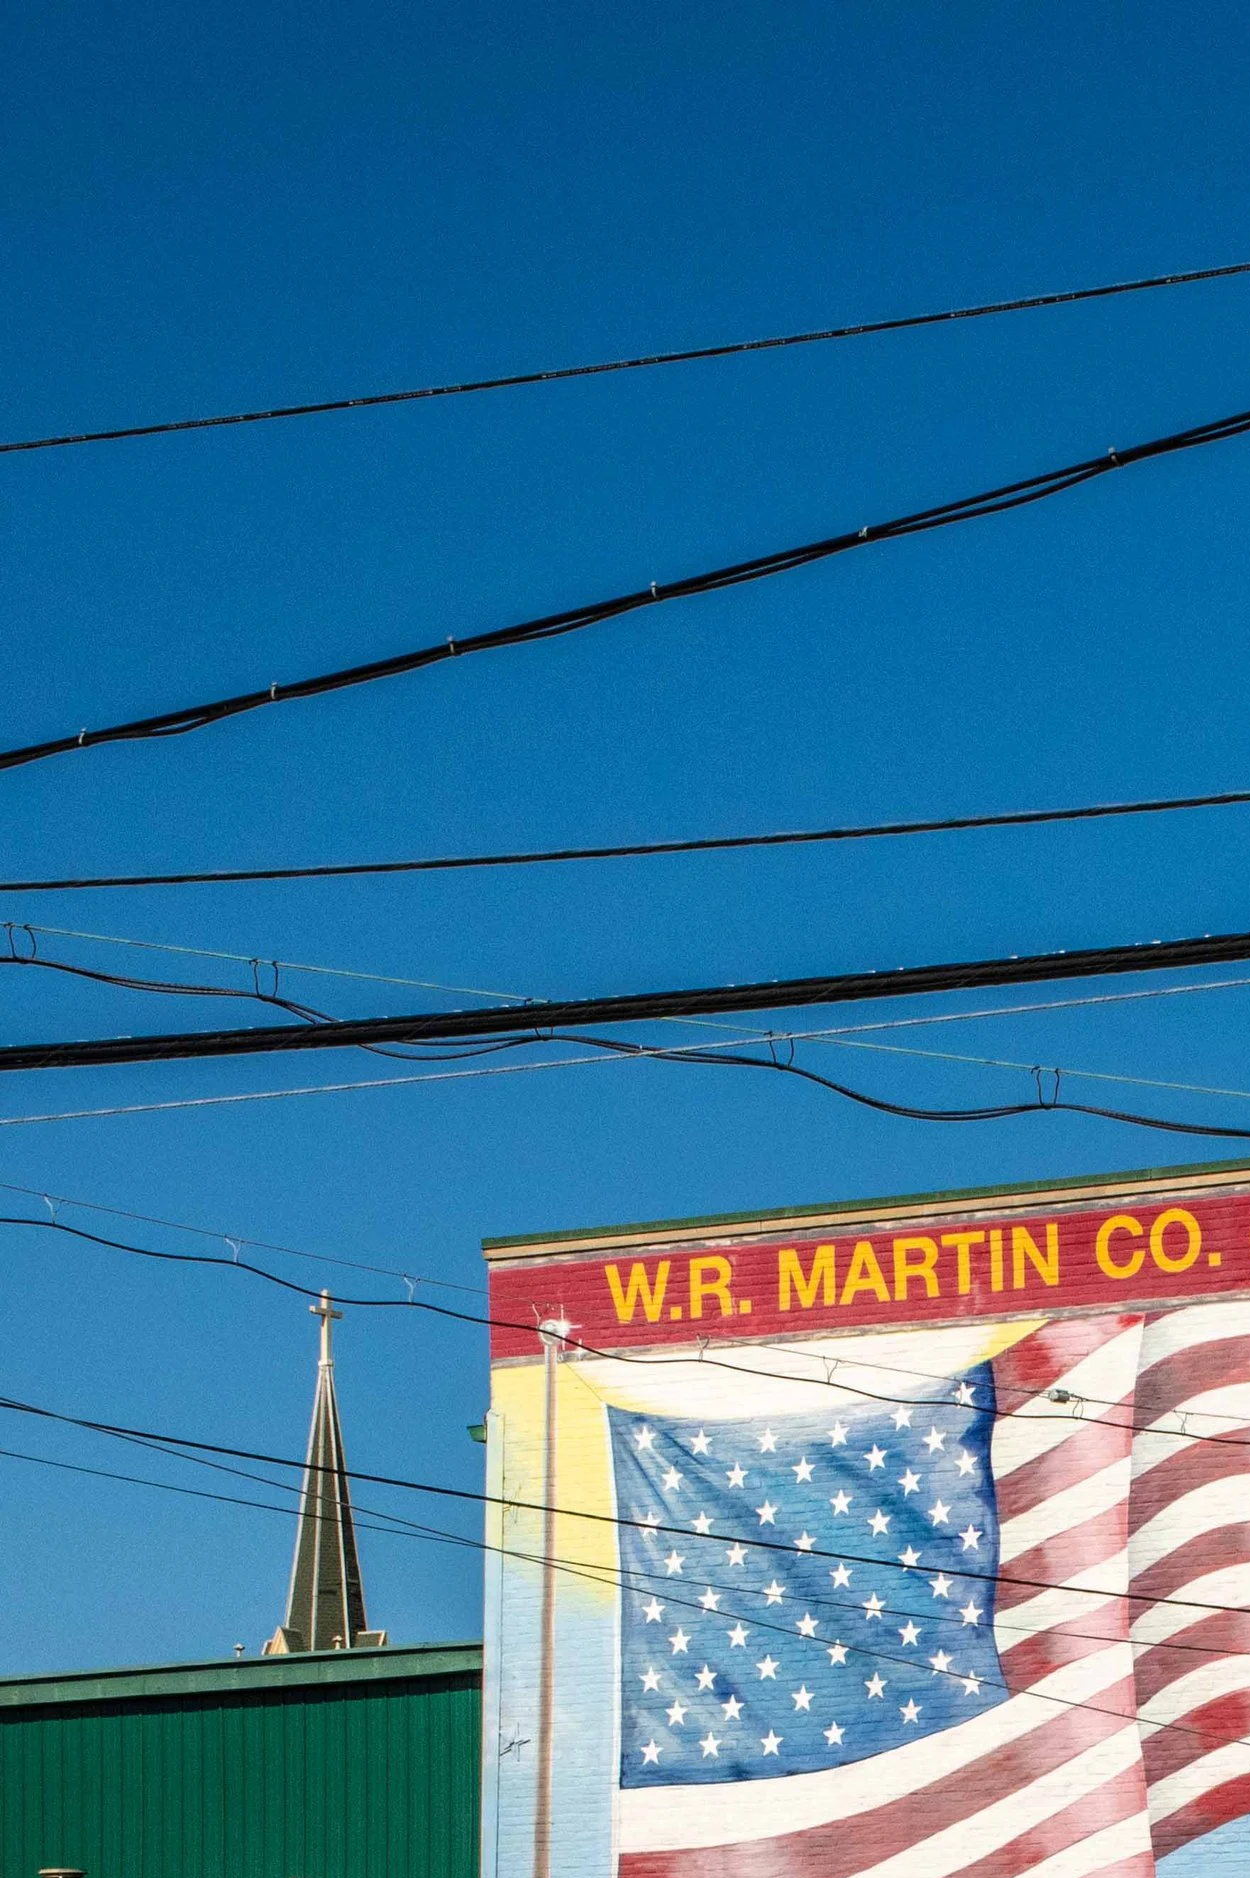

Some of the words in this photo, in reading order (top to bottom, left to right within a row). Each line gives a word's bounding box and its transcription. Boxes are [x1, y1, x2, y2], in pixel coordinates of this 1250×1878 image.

[604, 1254, 752, 1324] W.R.
[777, 1222, 1060, 1312] MARTIN
[1095, 1207, 1222, 1280] CO.
